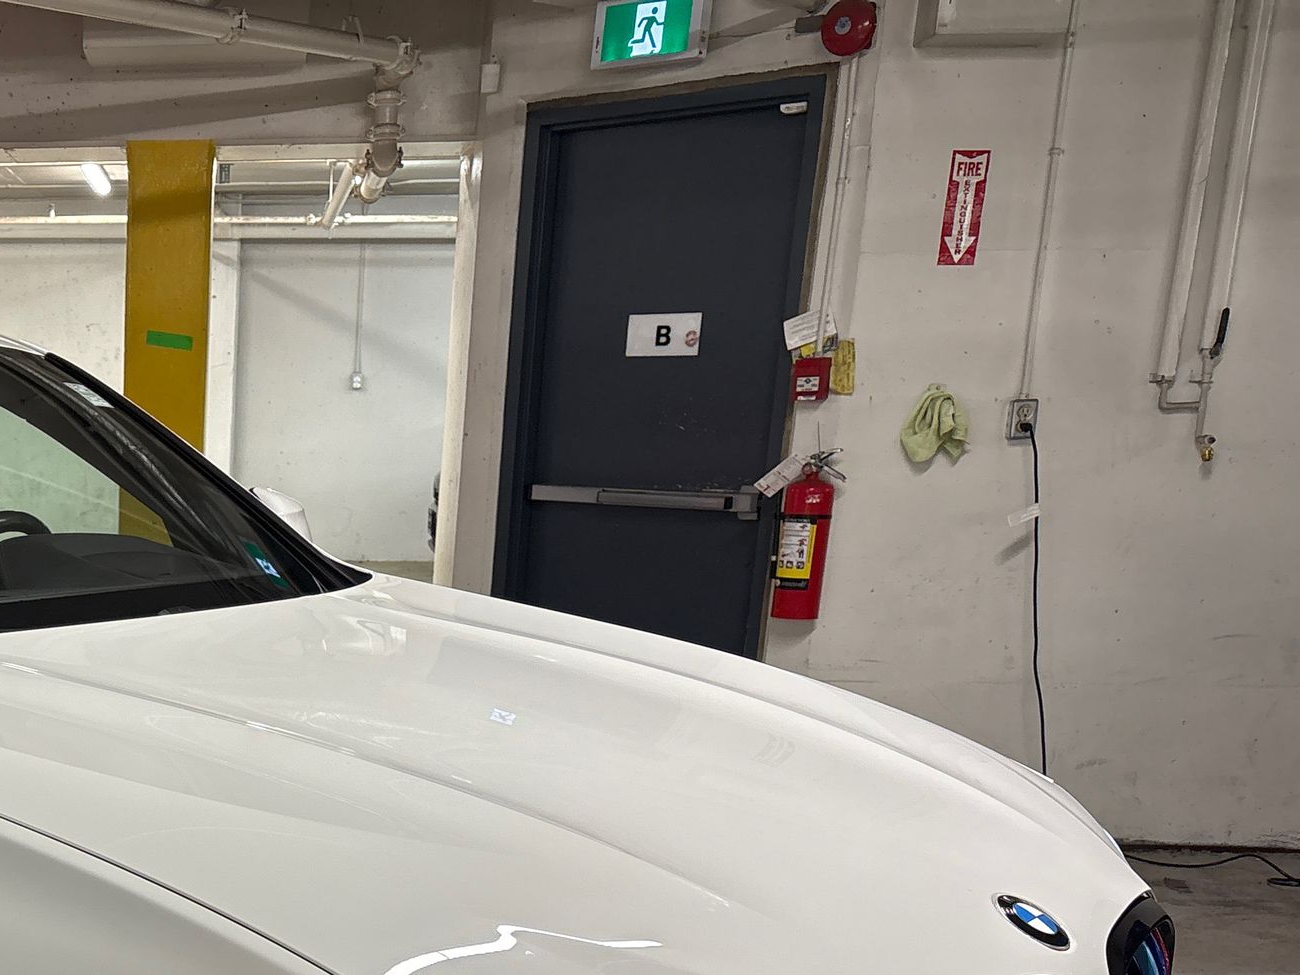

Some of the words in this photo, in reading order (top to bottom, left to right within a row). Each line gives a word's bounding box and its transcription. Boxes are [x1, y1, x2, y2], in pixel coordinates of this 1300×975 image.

[956, 161, 983, 177] FIRE
[954, 180, 971, 255] EXTINGUISHER
[655, 325, 671, 346] B
